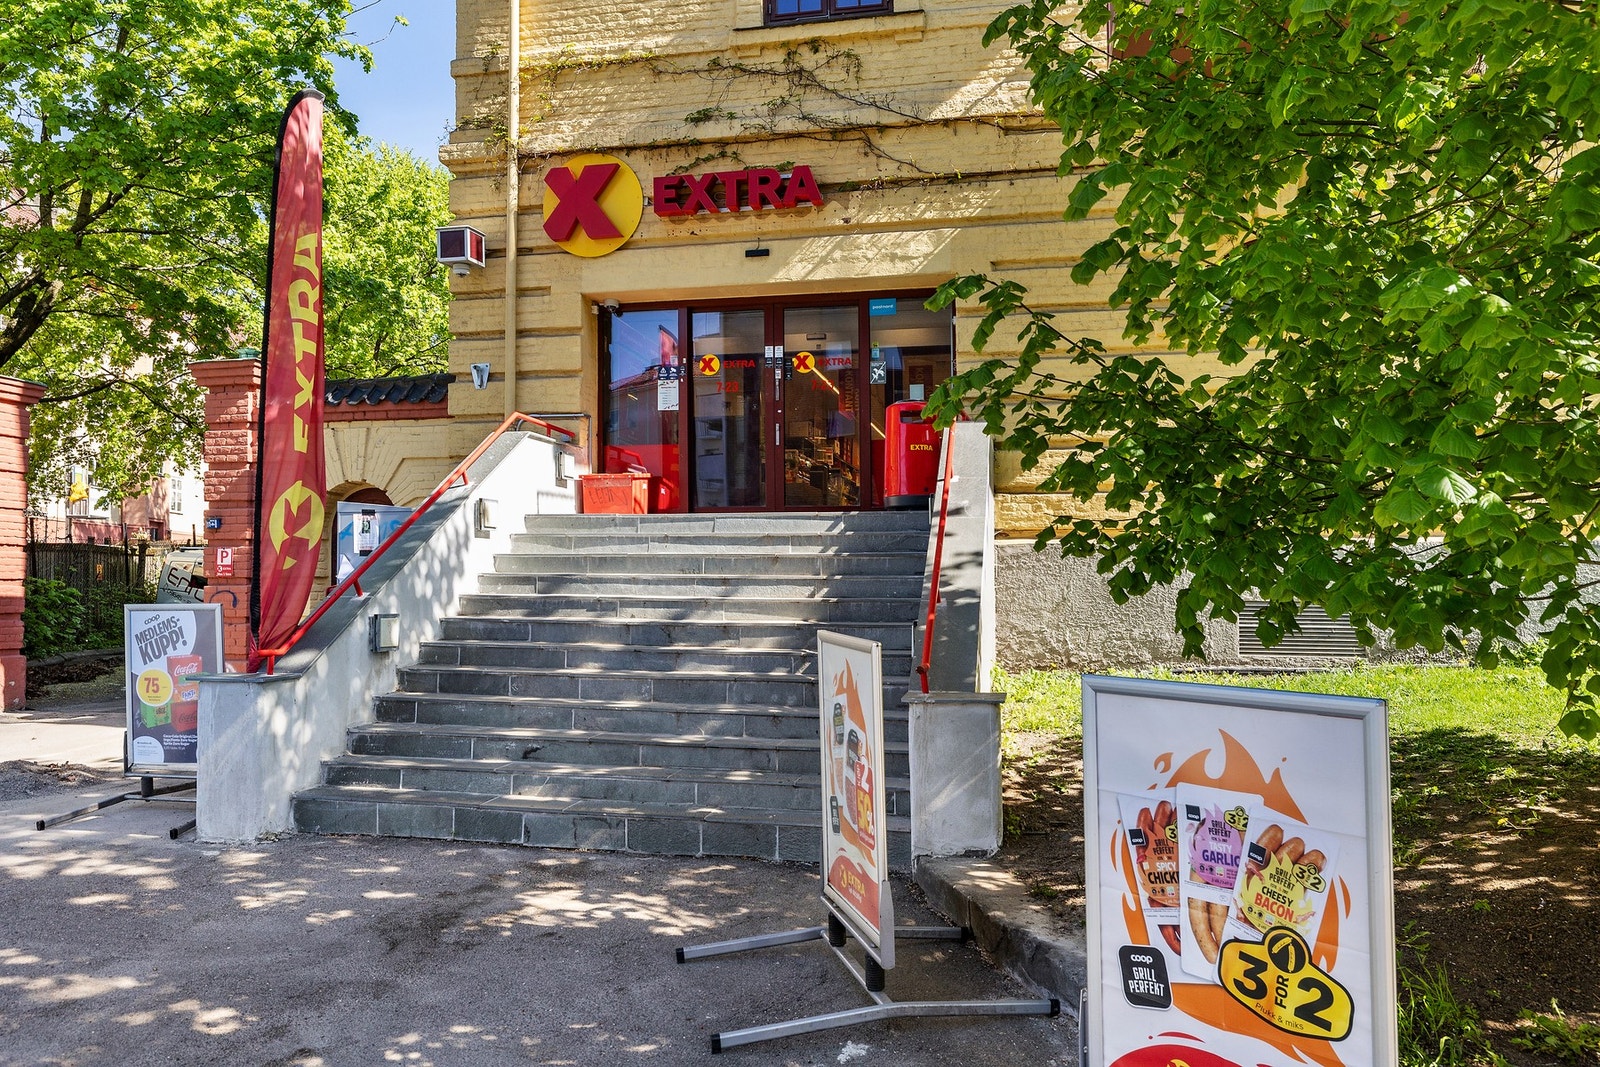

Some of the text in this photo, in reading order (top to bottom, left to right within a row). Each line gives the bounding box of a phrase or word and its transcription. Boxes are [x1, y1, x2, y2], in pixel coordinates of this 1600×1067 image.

[653, 165, 824, 217] EXTRA
[288, 233, 320, 454] EXTRA
[723, 360, 756, 369] EXTRA
[716, 381, 739, 393] 7-23
[220, 550, 229, 563] P
[144, 614, 160, 625] coop
[135, 616, 180, 646] MEDLEMS-
[139, 626, 188, 666] KUPP!
[144, 677, 160, 694] 75
[1208, 827, 1231, 839] PERFEKT
[1211, 820, 1227, 830] GRILL
[1154, 839, 1169, 847] GRILL
[1208, 841, 1233, 853] TASTY
[1156, 862, 1176, 871] SPICY
[1275, 867, 1292, 880] GRILL
[1269, 873, 1295, 891] PERFEKT
[1295, 866, 1306, 880] 3
[1310, 876, 1322, 891] 2
[1261, 886, 1294, 907] CHEESY
[1254, 892, 1295, 922] BACON
[1130, 954, 1153, 964] coop
[1133, 966, 1157, 981] GRILL
[1129, 980, 1165, 997] PERFEKT
[1233, 950, 1334, 1032] 3 FOR 2
[1255, 1003, 1277, 1022] Plukk
[1285, 1019, 1304, 1030] miks
